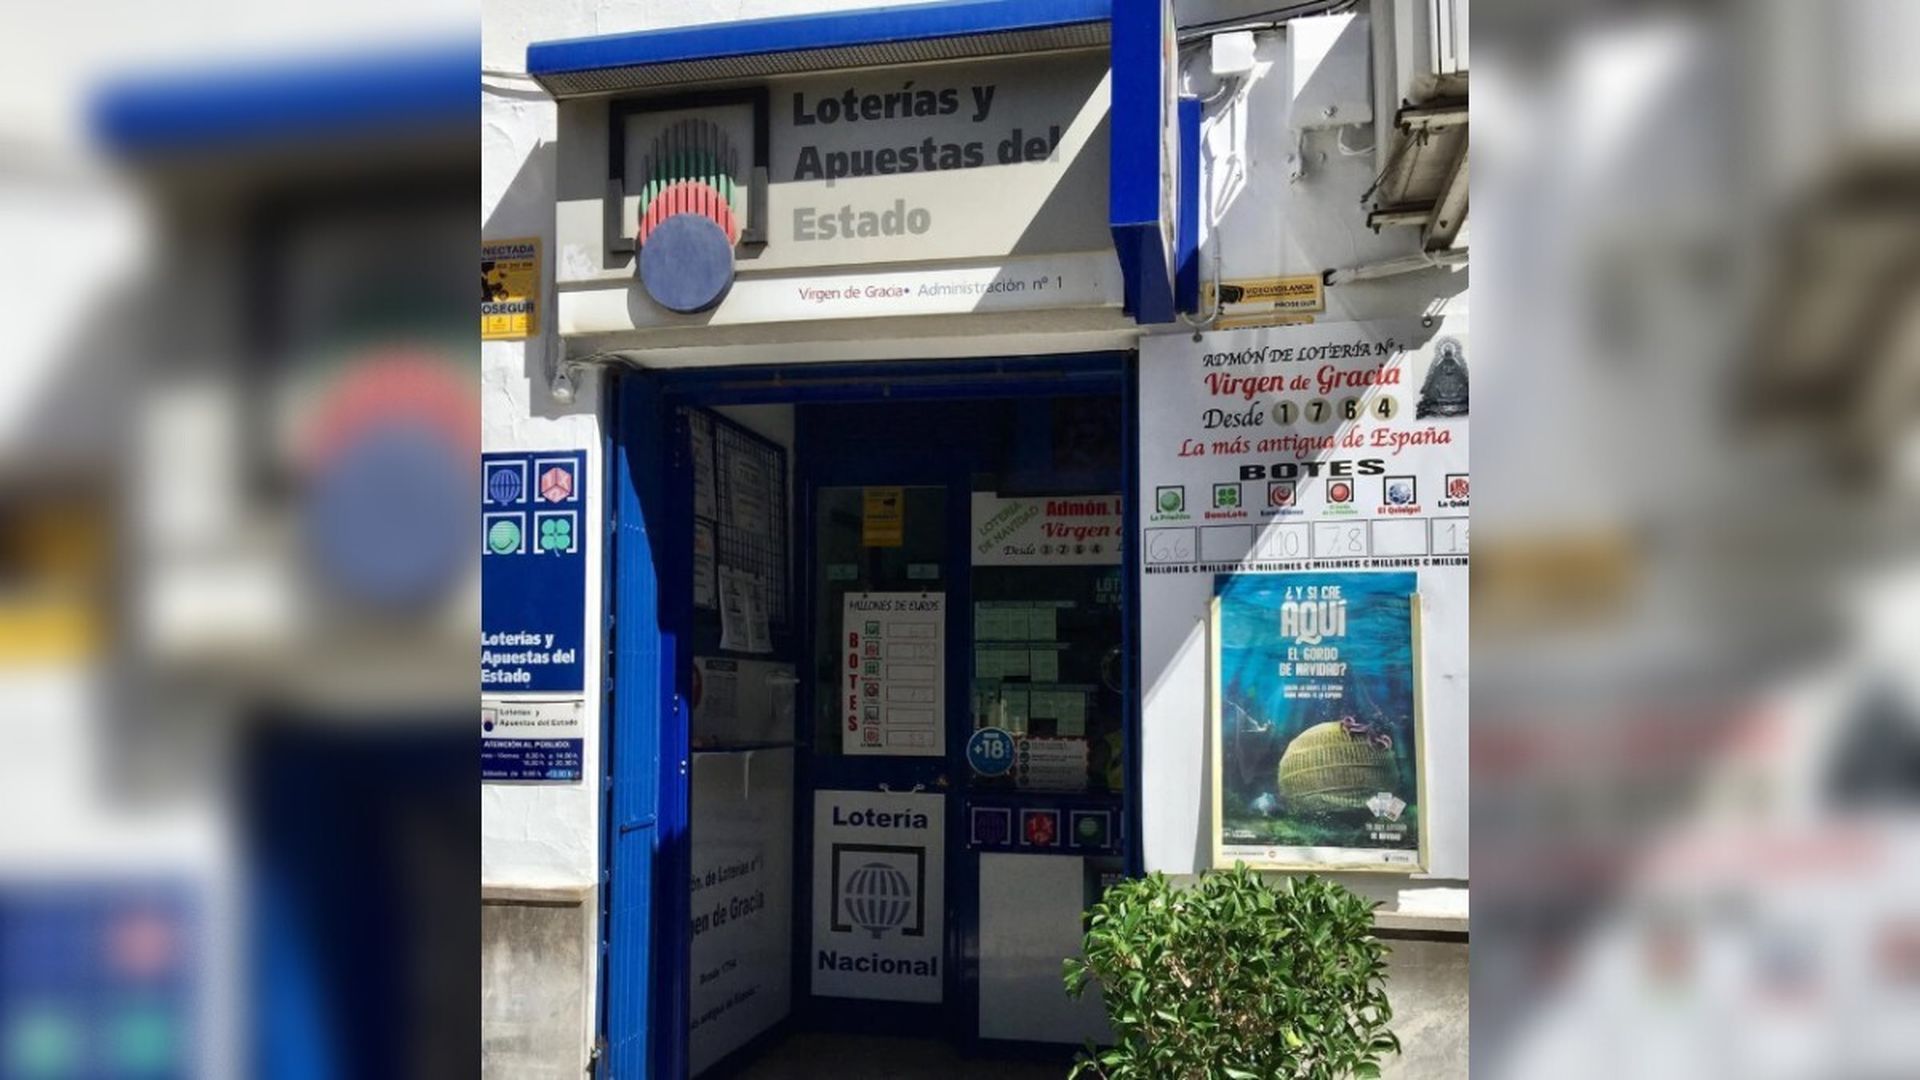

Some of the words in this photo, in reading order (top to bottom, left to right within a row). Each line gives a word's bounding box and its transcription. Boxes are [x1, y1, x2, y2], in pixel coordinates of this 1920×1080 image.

[792, 81, 959, 127] Loterías
[971, 85, 996, 123] y
[792, 137, 984, 187] Apuestas
[997, 126, 1061, 166] del
[792, 199, 932, 242] Estado
[799, 286, 841, 304] Virgen
[843, 286, 861, 300] de
[917, 278, 1025, 298] Administración
[1032, 276, 1049, 292] nº
[1055, 276, 1063, 291] 1
[1203, 346, 1269, 367] ADMÓN
[1271, 347, 1293, 362] DE
[1297, 343, 1372, 362] LOTERÍA
[1204, 370, 1284, 400] Virgen
[1289, 374, 1312, 391] de
[1316, 363, 1401, 394] Gracia
[1203, 402, 1264, 429] Desde
[1178, 438, 1206, 457] La
[1212, 436, 1251, 455] más
[1257, 433, 1336, 458] antigua
[1341, 428, 1366, 448] de
[1370, 427, 1452, 455] España
[1240, 459, 1386, 481] BOTES
[1046, 500, 1111, 517] Admón.
[1041, 523, 1110, 542] Virgen
[1145, 565, 1190, 574] MILLONES
[1199, 564, 1246, 573] MILLONES
[1256, 562, 1303, 571] MILLONES
[1312, 560, 1361, 569] MILLONES
[1371, 558, 1420, 568] MILLONES
[1307, 586, 1319, 599] SI
[1280, 599, 1347, 645] AQUÍ
[481, 630, 542, 647] Loterías
[545, 633, 555, 649] y
[481, 650, 550, 668] Apuestas
[552, 648, 575, 664] del
[1288, 648, 1301, 659] EL
[1303, 647, 1339, 660] GORDO
[481, 668, 532, 683] Estado
[1279, 663, 1293, 676] DE
[1296, 663, 1347, 677] NAVIDAD?
[974, 739, 1004, 760] +18
[832, 805, 929, 829] Lotería
[713, 902, 727, 927] de
[730, 889, 764, 920] Gracia
[818, 951, 937, 977] Nacional
